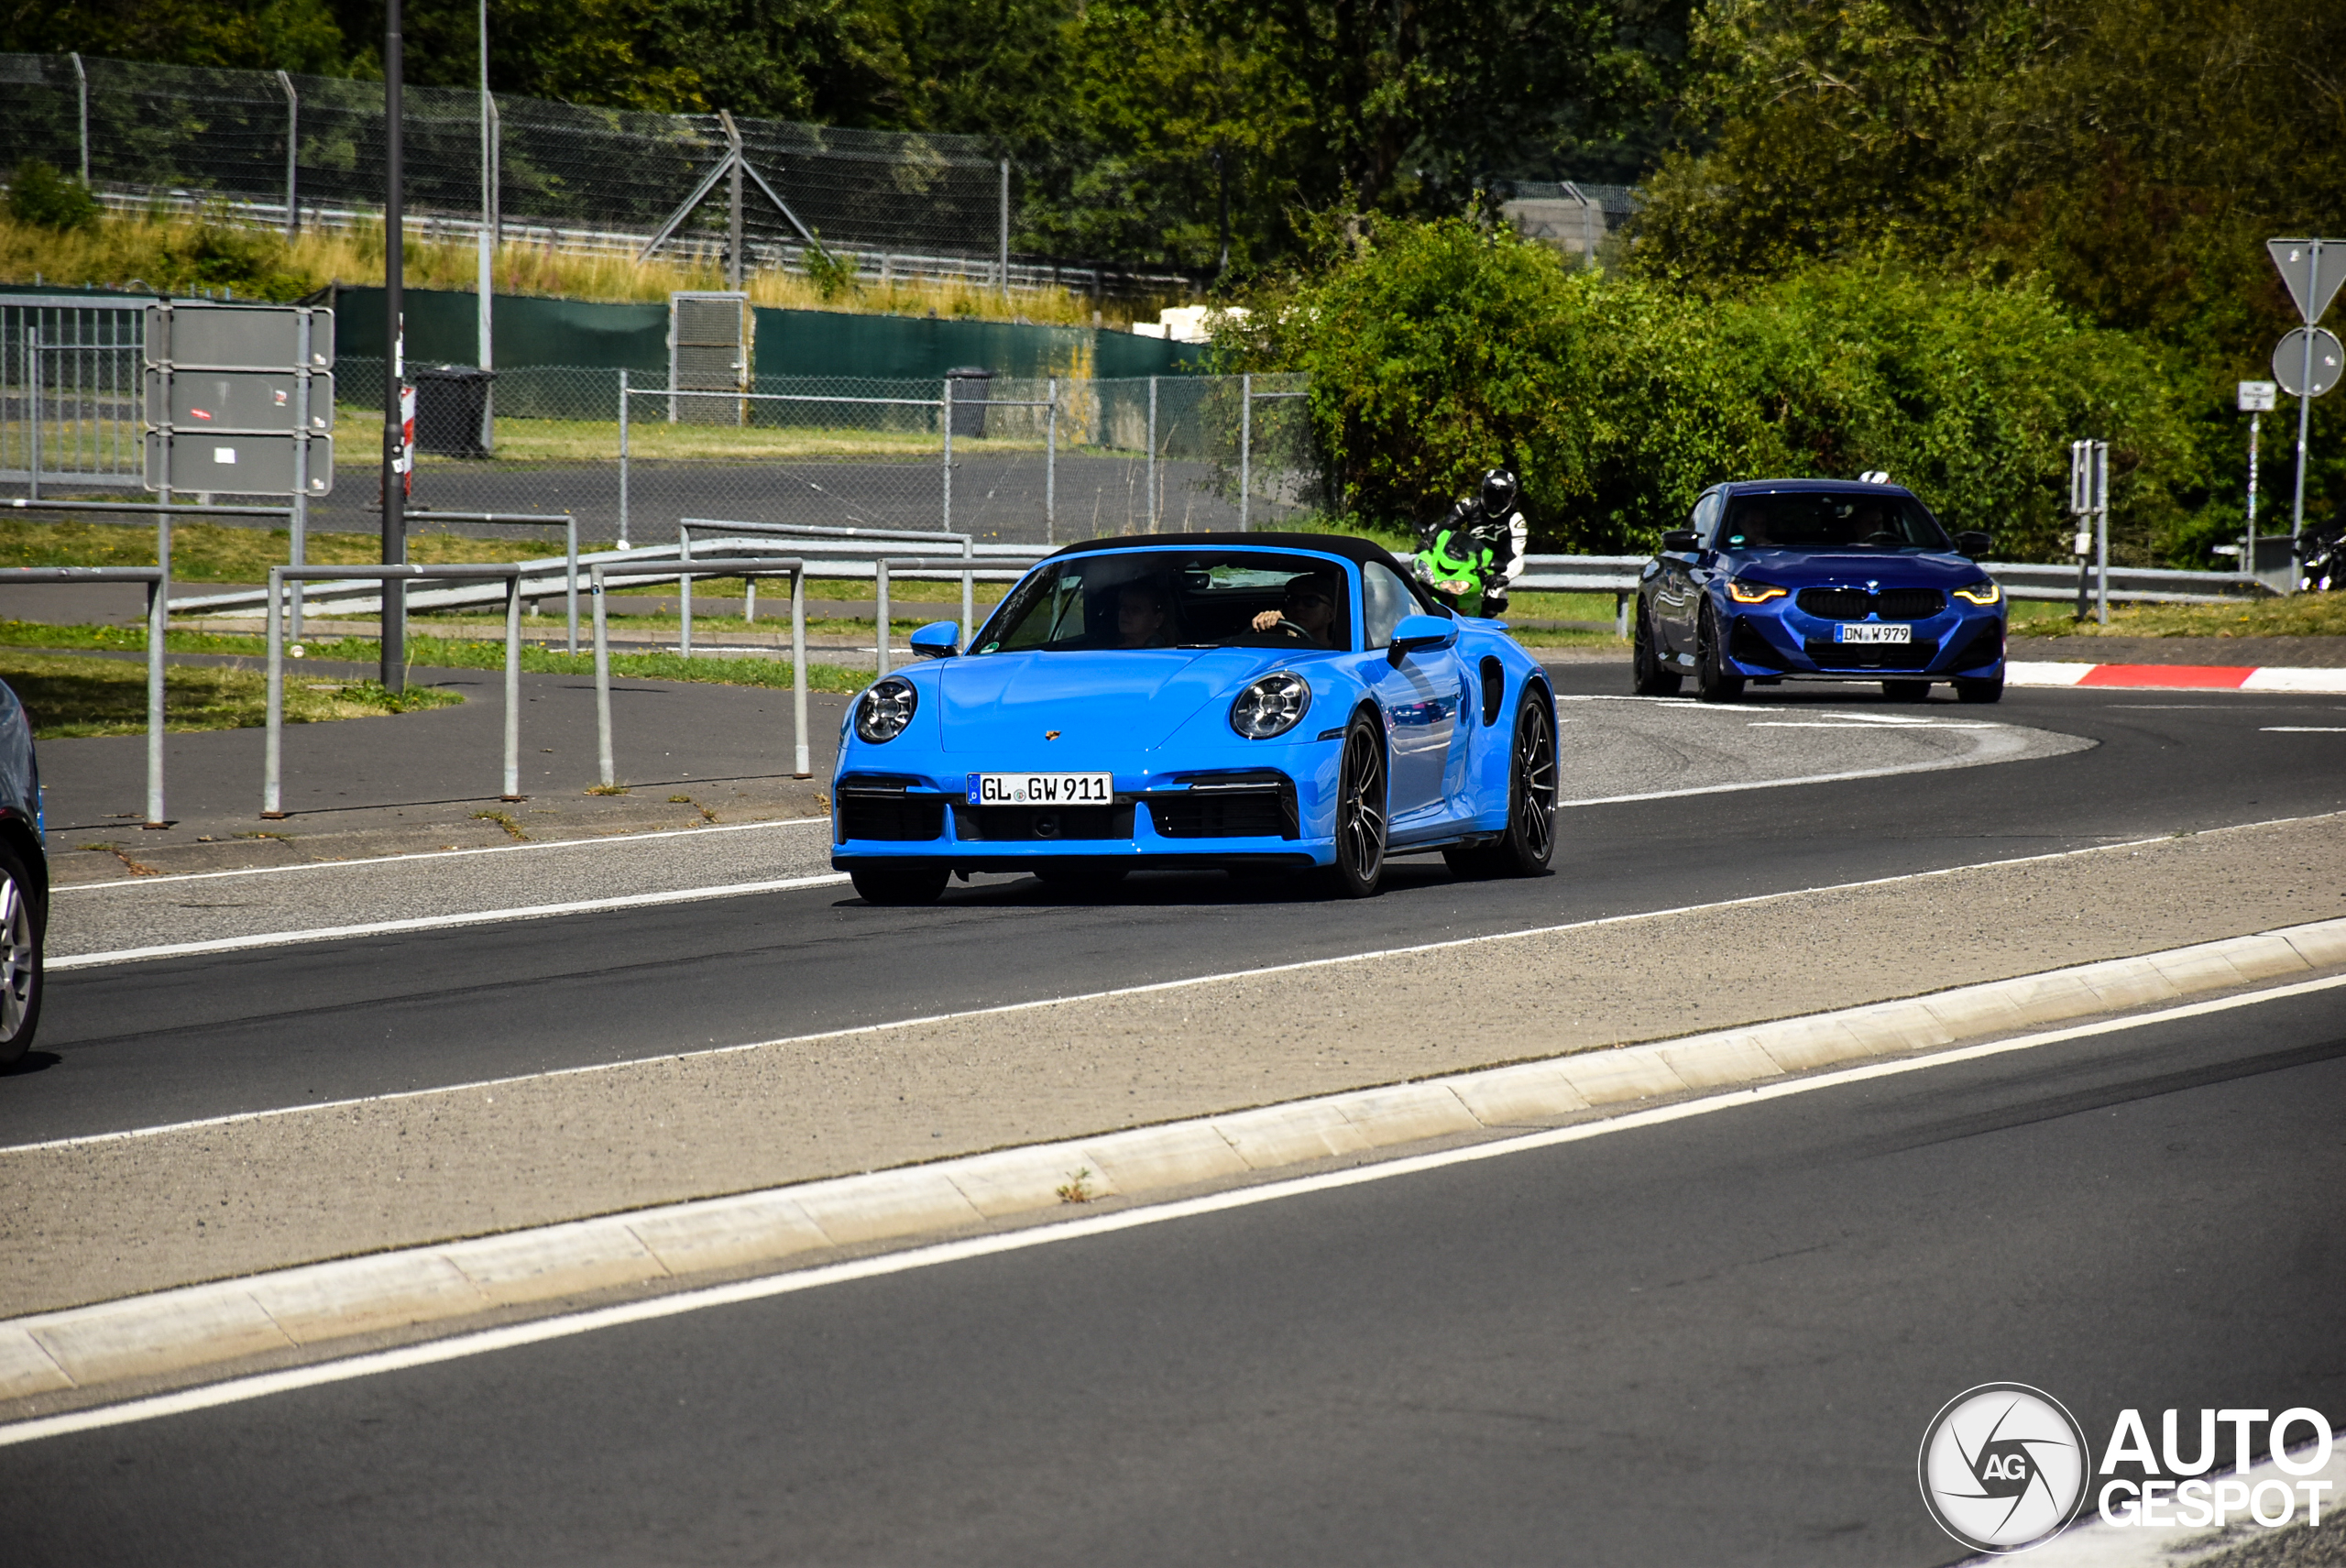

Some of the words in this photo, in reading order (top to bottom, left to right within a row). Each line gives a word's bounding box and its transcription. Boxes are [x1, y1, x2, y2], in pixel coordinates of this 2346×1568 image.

[1844, 627, 1862, 641] DN
[1871, 627, 1881, 641] W
[1884, 627, 1909, 641] 979
[981, 777, 1012, 800] GL
[1028, 777, 1058, 800] GW
[1063, 777, 1108, 800] 911
